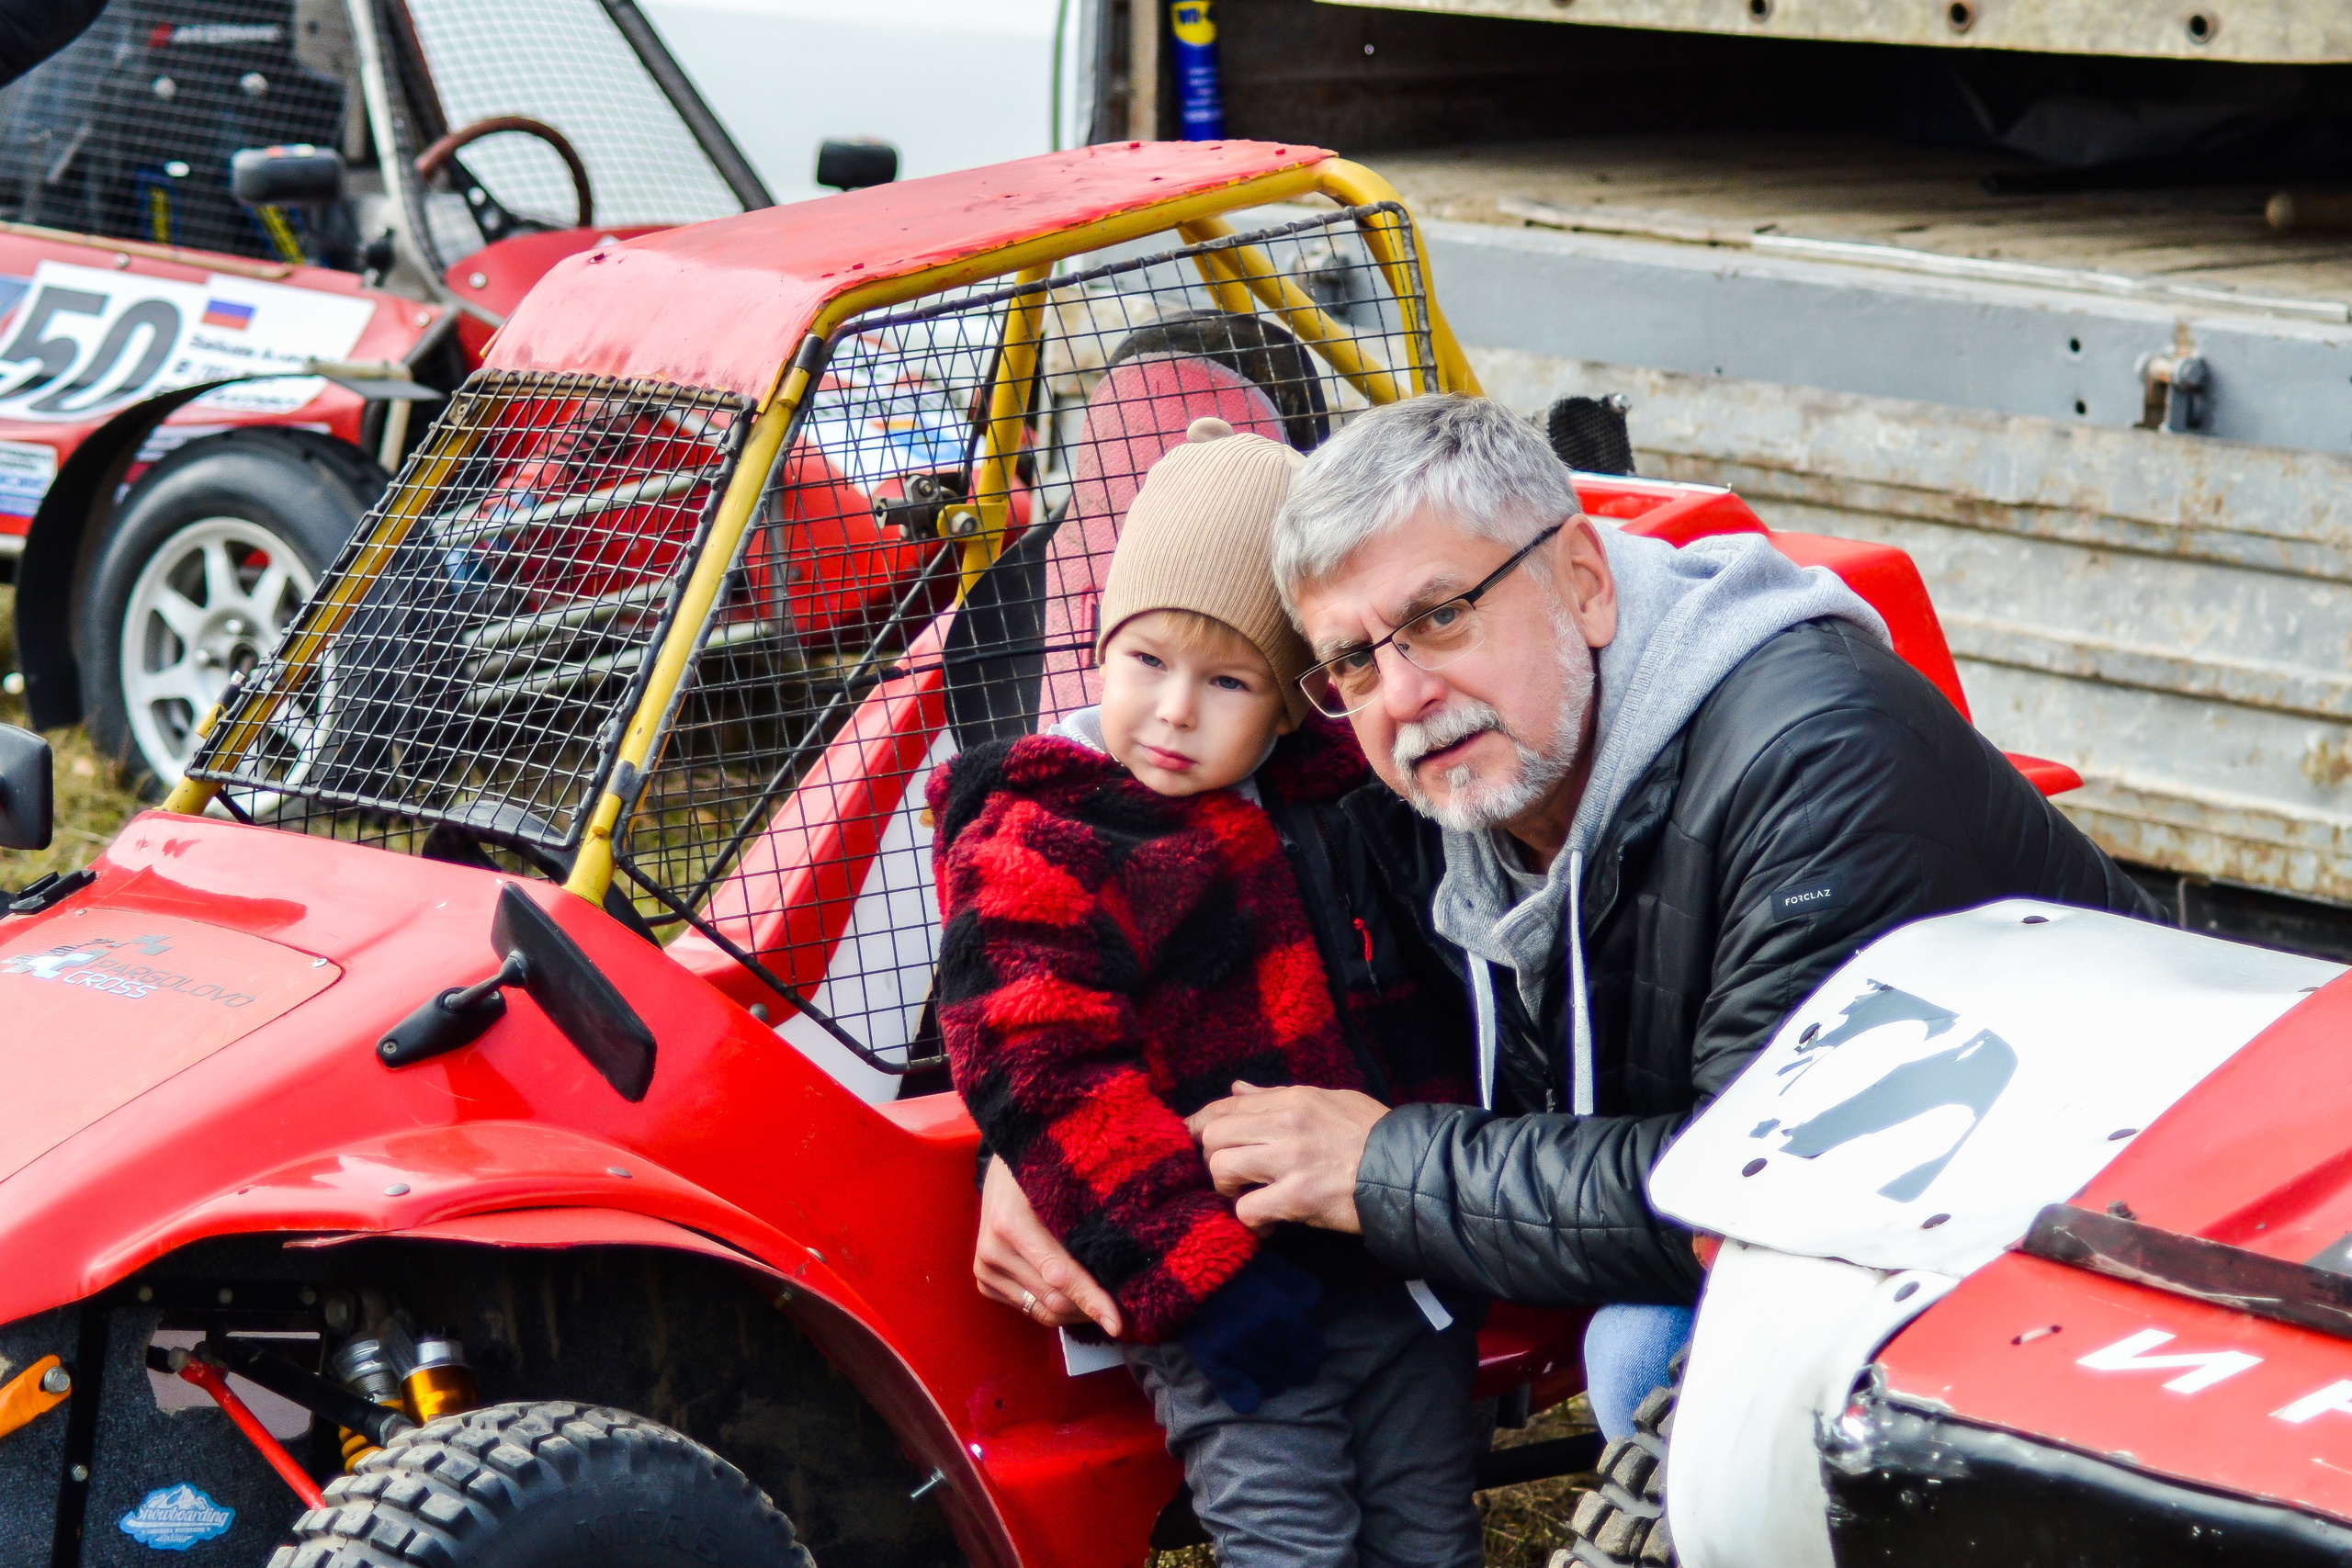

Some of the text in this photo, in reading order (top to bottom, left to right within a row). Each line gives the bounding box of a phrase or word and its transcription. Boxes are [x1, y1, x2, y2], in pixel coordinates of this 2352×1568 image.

[0, 286, 180, 412] 50
[1784, 888, 1832, 907] FORCLAZ
[62, 971, 159, 998] CROSS
[86, 958, 256, 1008] PARGOLOVO
[136, 1505, 230, 1528] Snowboarding
